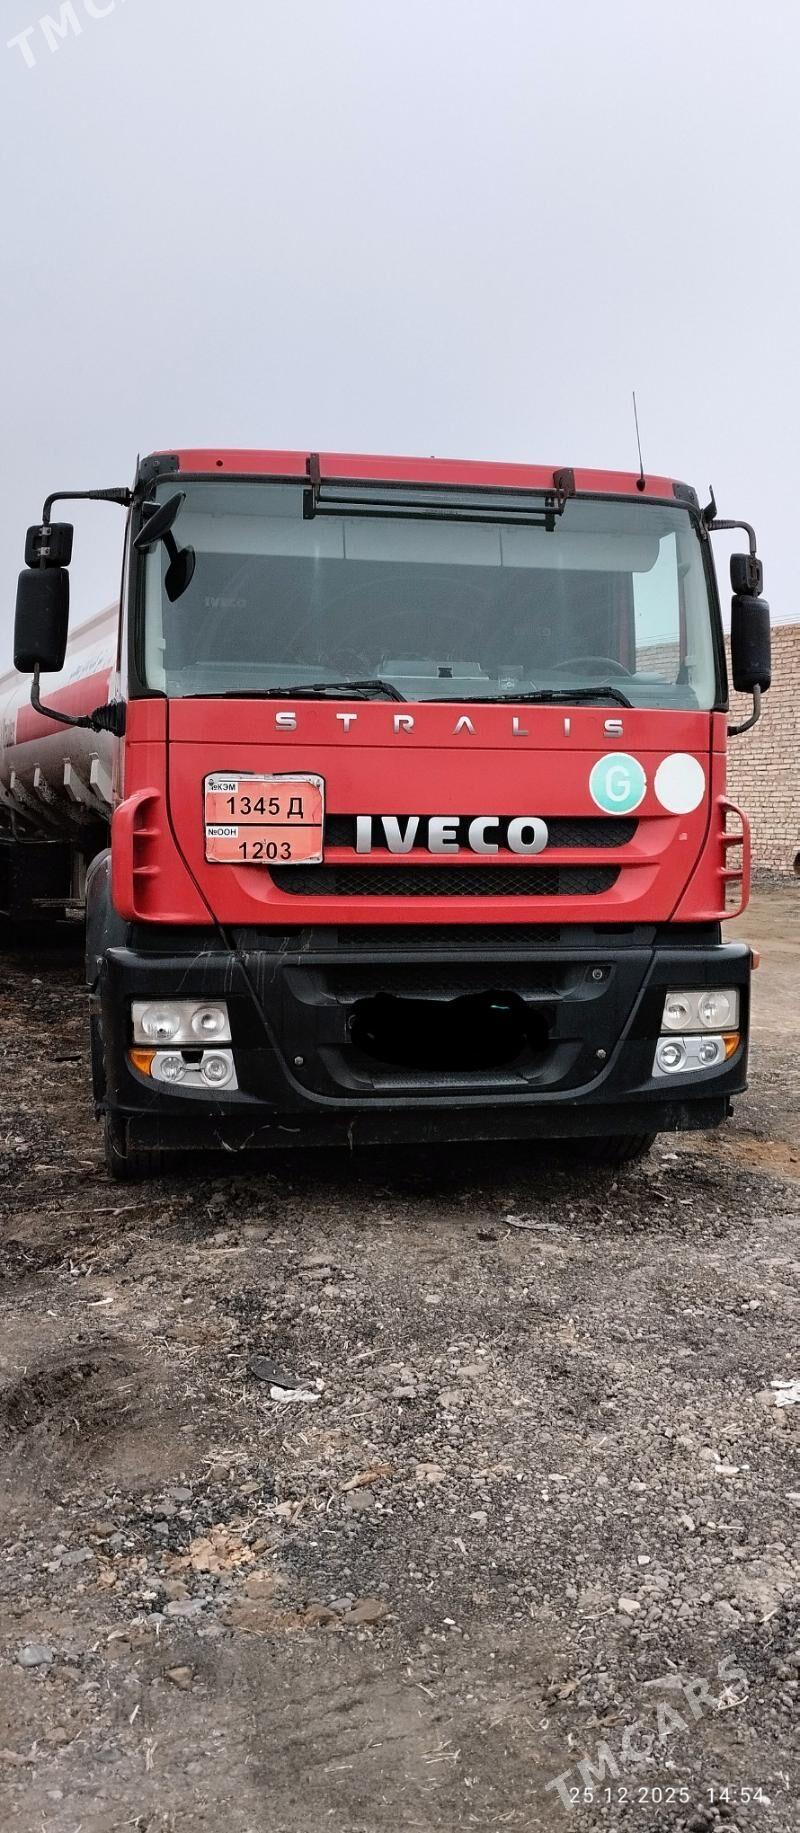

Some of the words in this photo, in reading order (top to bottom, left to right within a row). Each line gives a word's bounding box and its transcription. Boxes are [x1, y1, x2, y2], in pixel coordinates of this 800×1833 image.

[275, 711, 624, 737] STRALIS
[605, 765, 632, 802] G
[226, 796, 280, 815] 1345
[287, 797, 304, 819] Д
[207, 828, 236, 836] №ООН
[356, 815, 549, 855] IVECO
[238, 841, 292, 860] 1203
